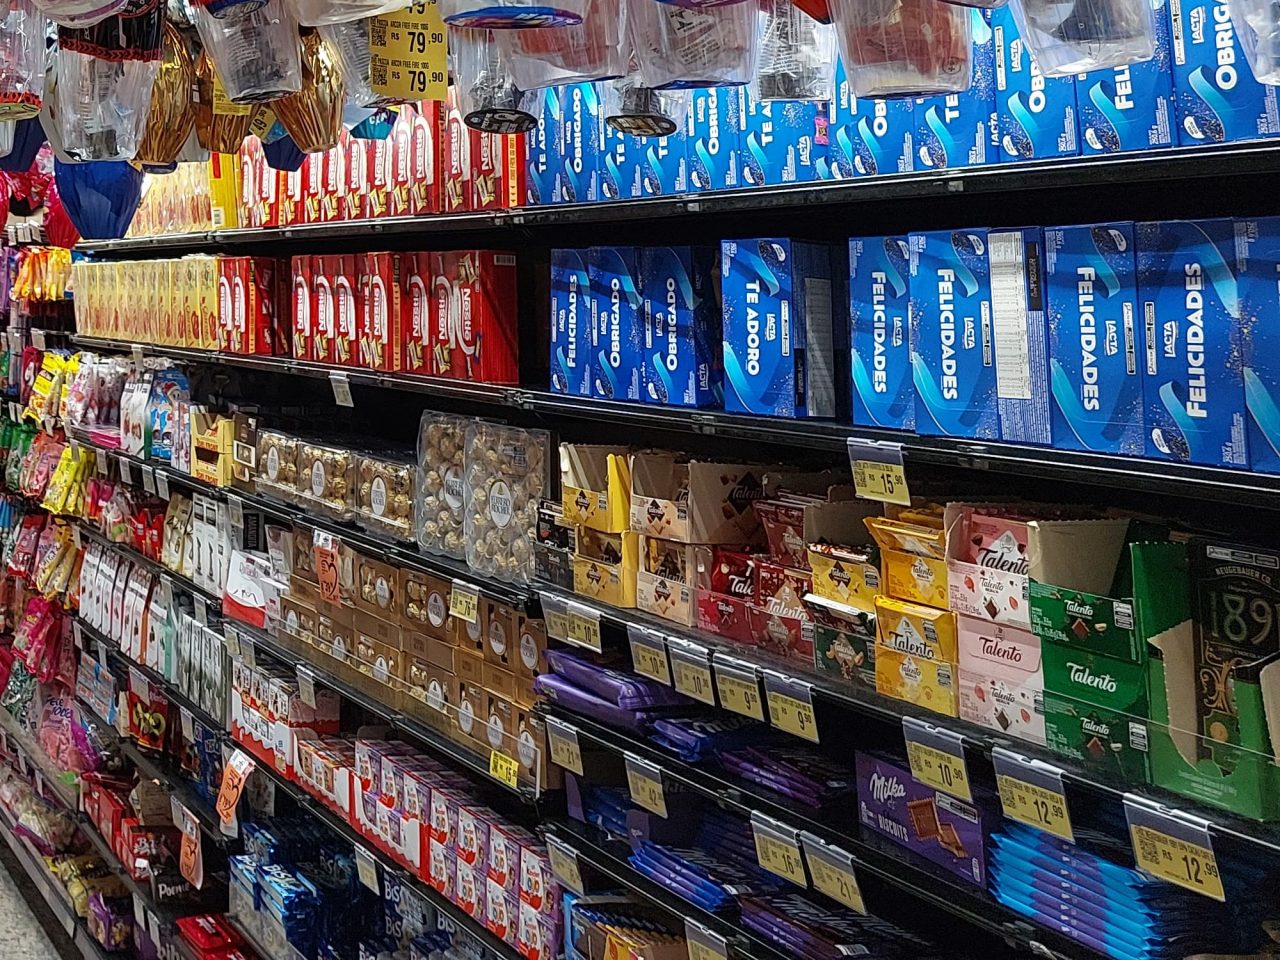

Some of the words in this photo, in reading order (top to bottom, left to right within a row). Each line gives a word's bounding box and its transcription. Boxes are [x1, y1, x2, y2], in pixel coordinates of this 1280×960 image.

[573, 88, 582, 173] OBRIGADO
[761, 122, 773, 147] TE
[539, 153, 547, 173] TE
[746, 280, 760, 304] TE
[566, 275, 577, 368] FELICIDADES
[610, 278, 620, 368] OBRIGADO
[666, 277, 677, 371] OBRIGADO
[872, 271, 887, 393] FELICIDADES
[892, 317, 903, 347] LACTA
[937, 269, 958, 400] FELICIDADES
[963, 317, 976, 350] LACTA
[746, 308, 760, 376] ADORO
[1076, 267, 1100, 411] FELICIDADES
[1104, 320, 1119, 356] LACTA
[1163, 321, 1176, 358] LACTA
[1185, 263, 1207, 418] FELICIDADES
[977, 548, 1029, 576] Talento
[766, 596, 810, 620] Talento
[1064, 598, 1093, 616] Talento
[889, 631, 935, 659] Talento
[979, 636, 1022, 663] Talento
[1066, 662, 1117, 693] Talento
[1080, 716, 1110, 735] Talento
[870, 773, 906, 801] Milka
[878, 814, 908, 841] BISCUITS
[1162, 849, 1172, 861] R$
